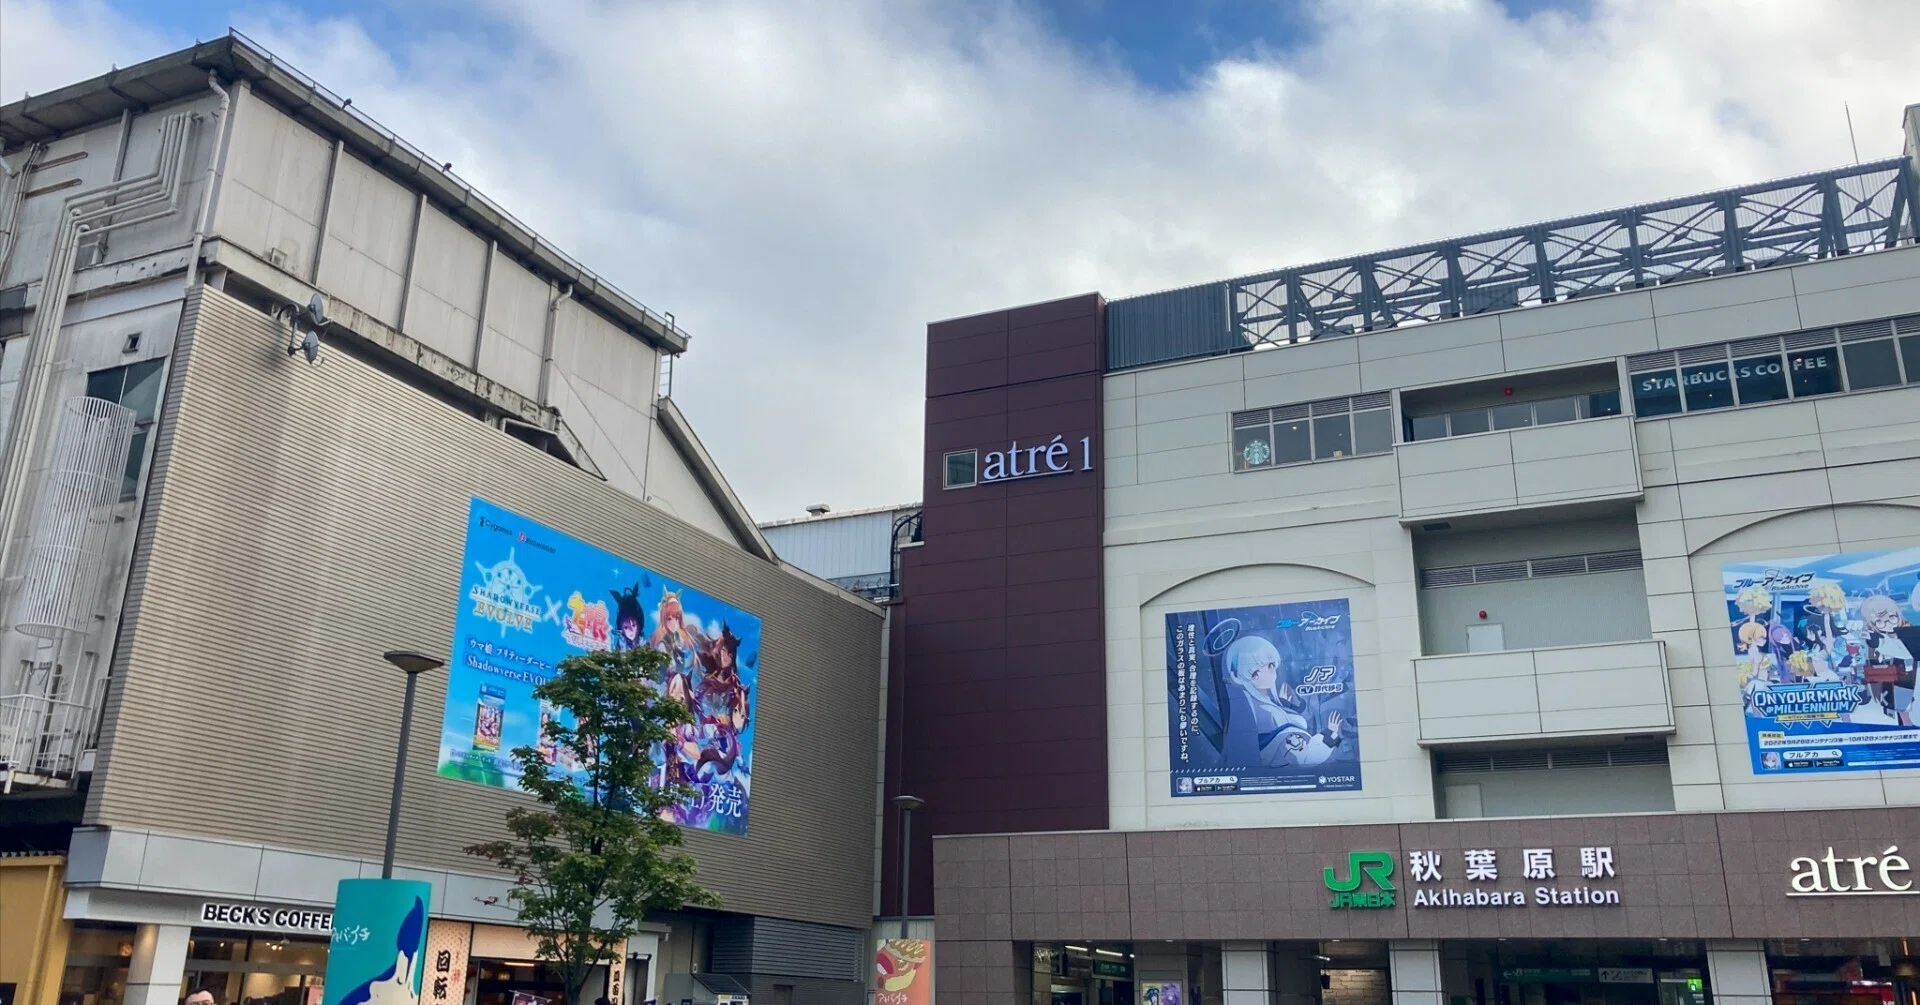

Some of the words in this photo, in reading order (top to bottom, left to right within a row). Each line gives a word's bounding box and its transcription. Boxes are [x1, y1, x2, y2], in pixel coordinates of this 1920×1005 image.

[1755, 356, 1827, 376] COFEE
[983, 434, 1069, 480] atré
[1080, 436, 1094, 471] 1
[1733, 573, 1815, 588] ブルーアーカイブ
[472, 585, 540, 614] SHADOWVERSE
[475, 600, 533, 631] EVOLVE
[470, 639, 493, 655] ウマ娘
[522, 671, 551, 687] EVOL
[1304, 665, 1336, 683] ノア
[1777, 690, 1816, 704] YOUR
[1816, 686, 1859, 702] MARK
[1326, 775, 1355, 783] YOSTAR
[1324, 851, 1397, 892] JR
[1409, 847, 1616, 882] 秋葉原駅
[1790, 845, 1913, 892] atré
[1328, 892, 1396, 908] JR東日本
[1414, 888, 1525, 907] Akihabara
[1535, 886, 1620, 905] Station
[202, 903, 271, 926] BECK'S
[274, 909, 335, 931] COFFE
[433, 949, 452, 1005] 回転
